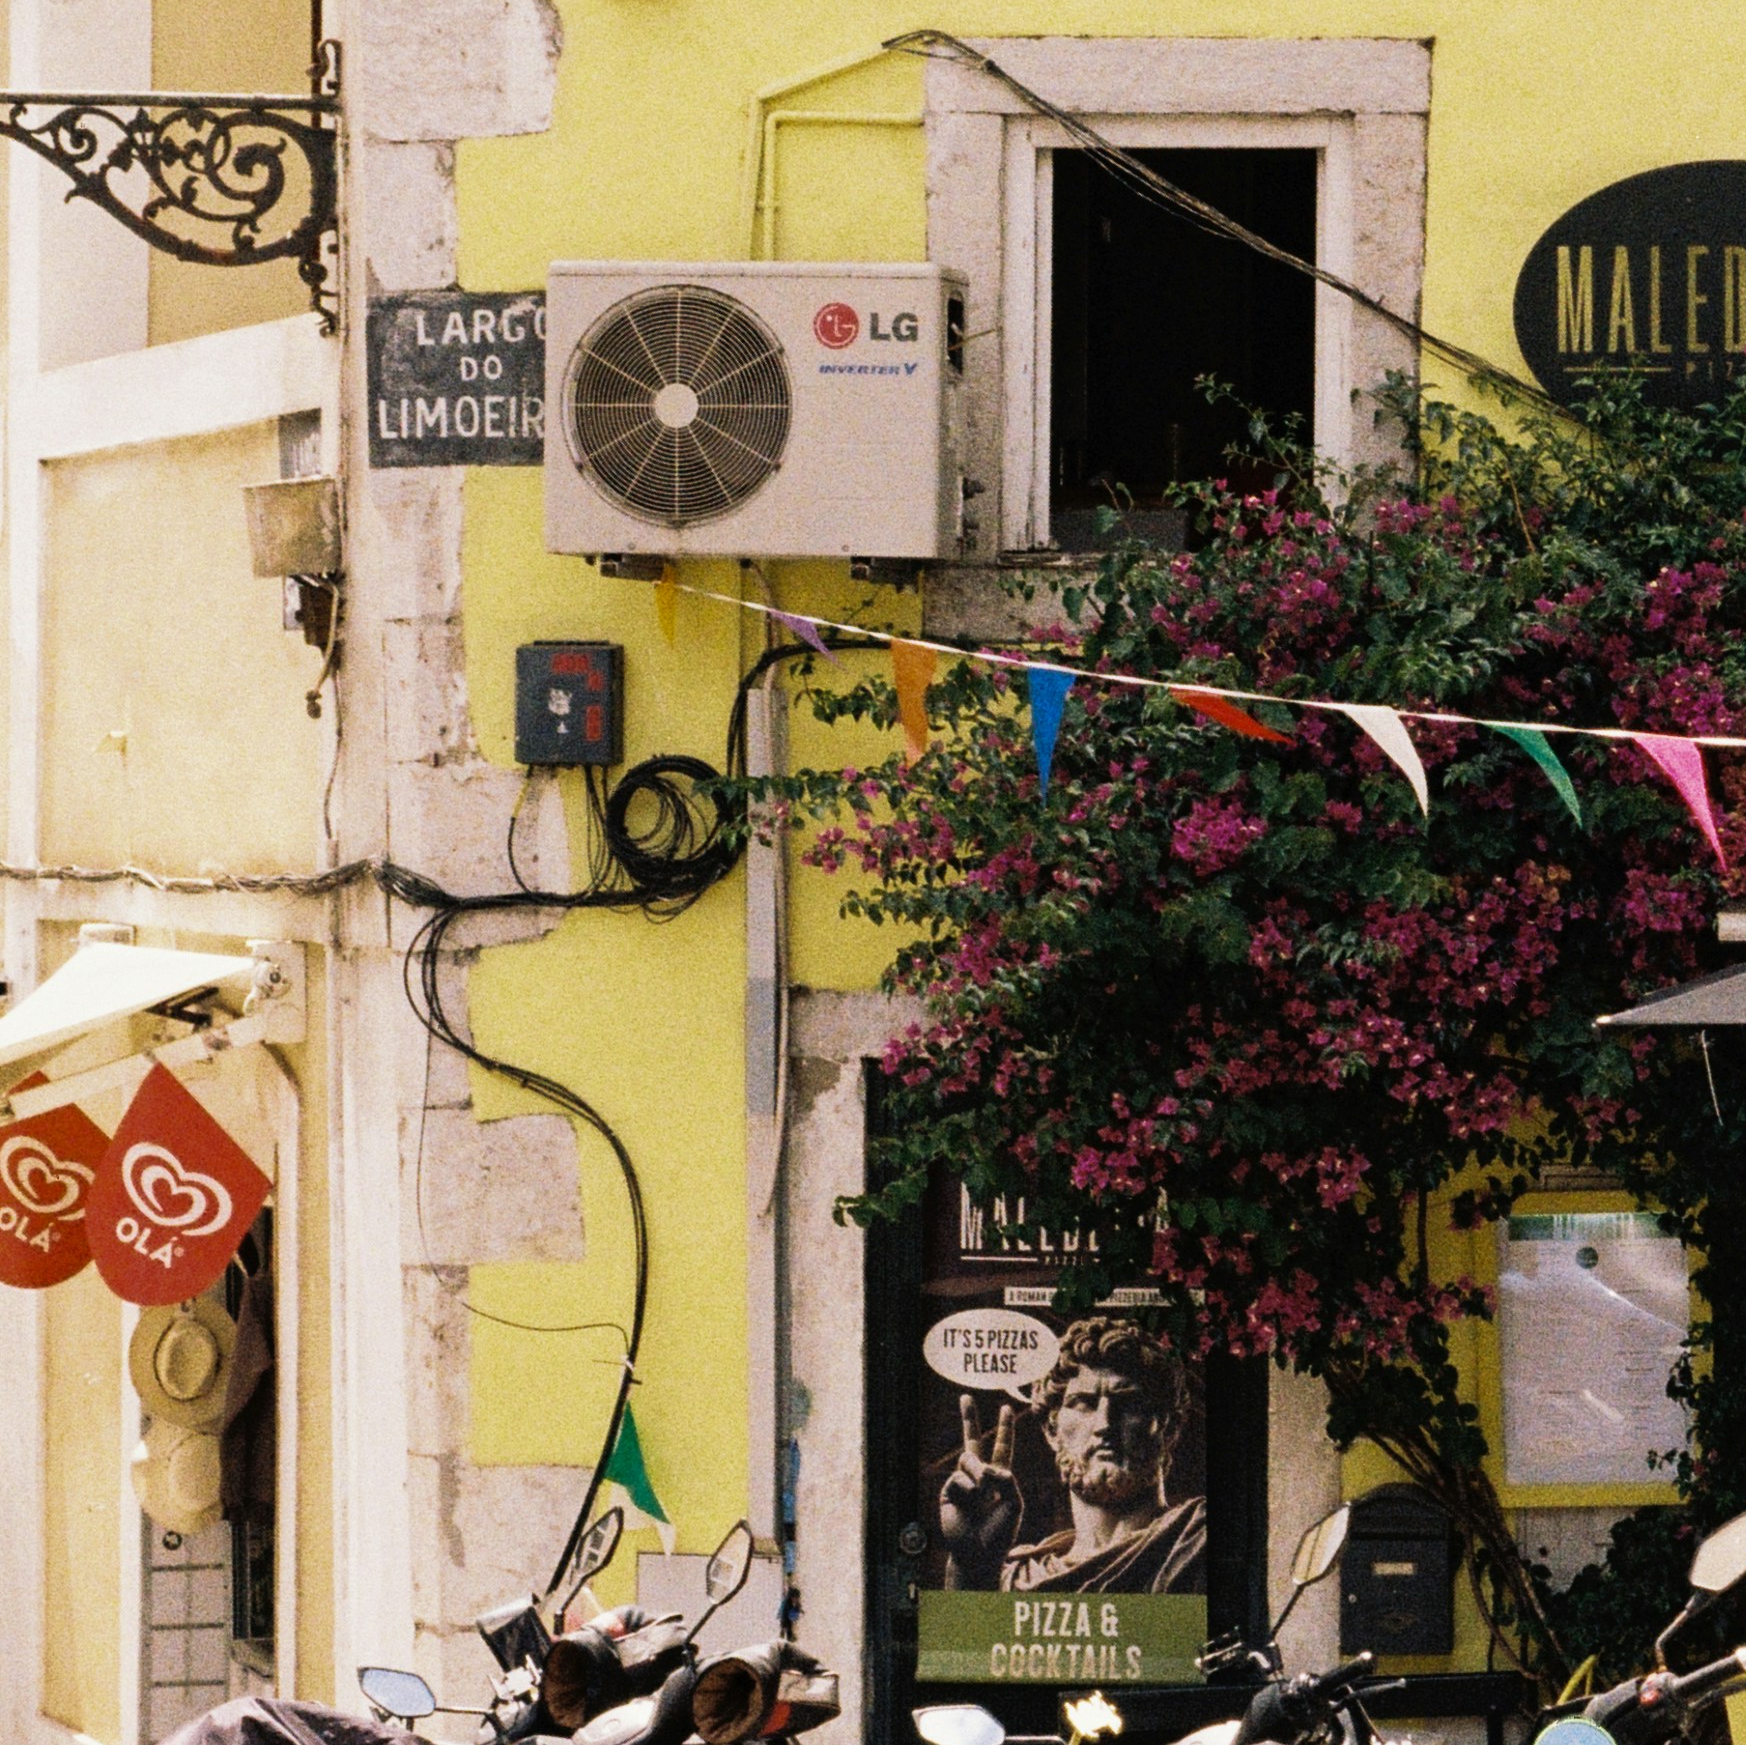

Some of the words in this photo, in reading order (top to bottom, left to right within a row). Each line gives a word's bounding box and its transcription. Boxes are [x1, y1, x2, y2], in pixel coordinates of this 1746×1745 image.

[870, 312, 918, 342] LG
[460, 355, 503, 381] DO
[377, 395, 546, 439] LIMOEIR
[115, 1216, 179, 1270] OLÁ
[943, 1328, 972, 1349] IT'S
[975, 1329, 985, 1349] 5
[987, 1329, 1039, 1350] PIZZAS
[963, 1352, 1018, 1374] PLEASE
[1014, 1601, 1091, 1638] PIZZA
[1100, 1602, 1119, 1638] &
[989, 1642, 1142, 1680] COCKTAILS
